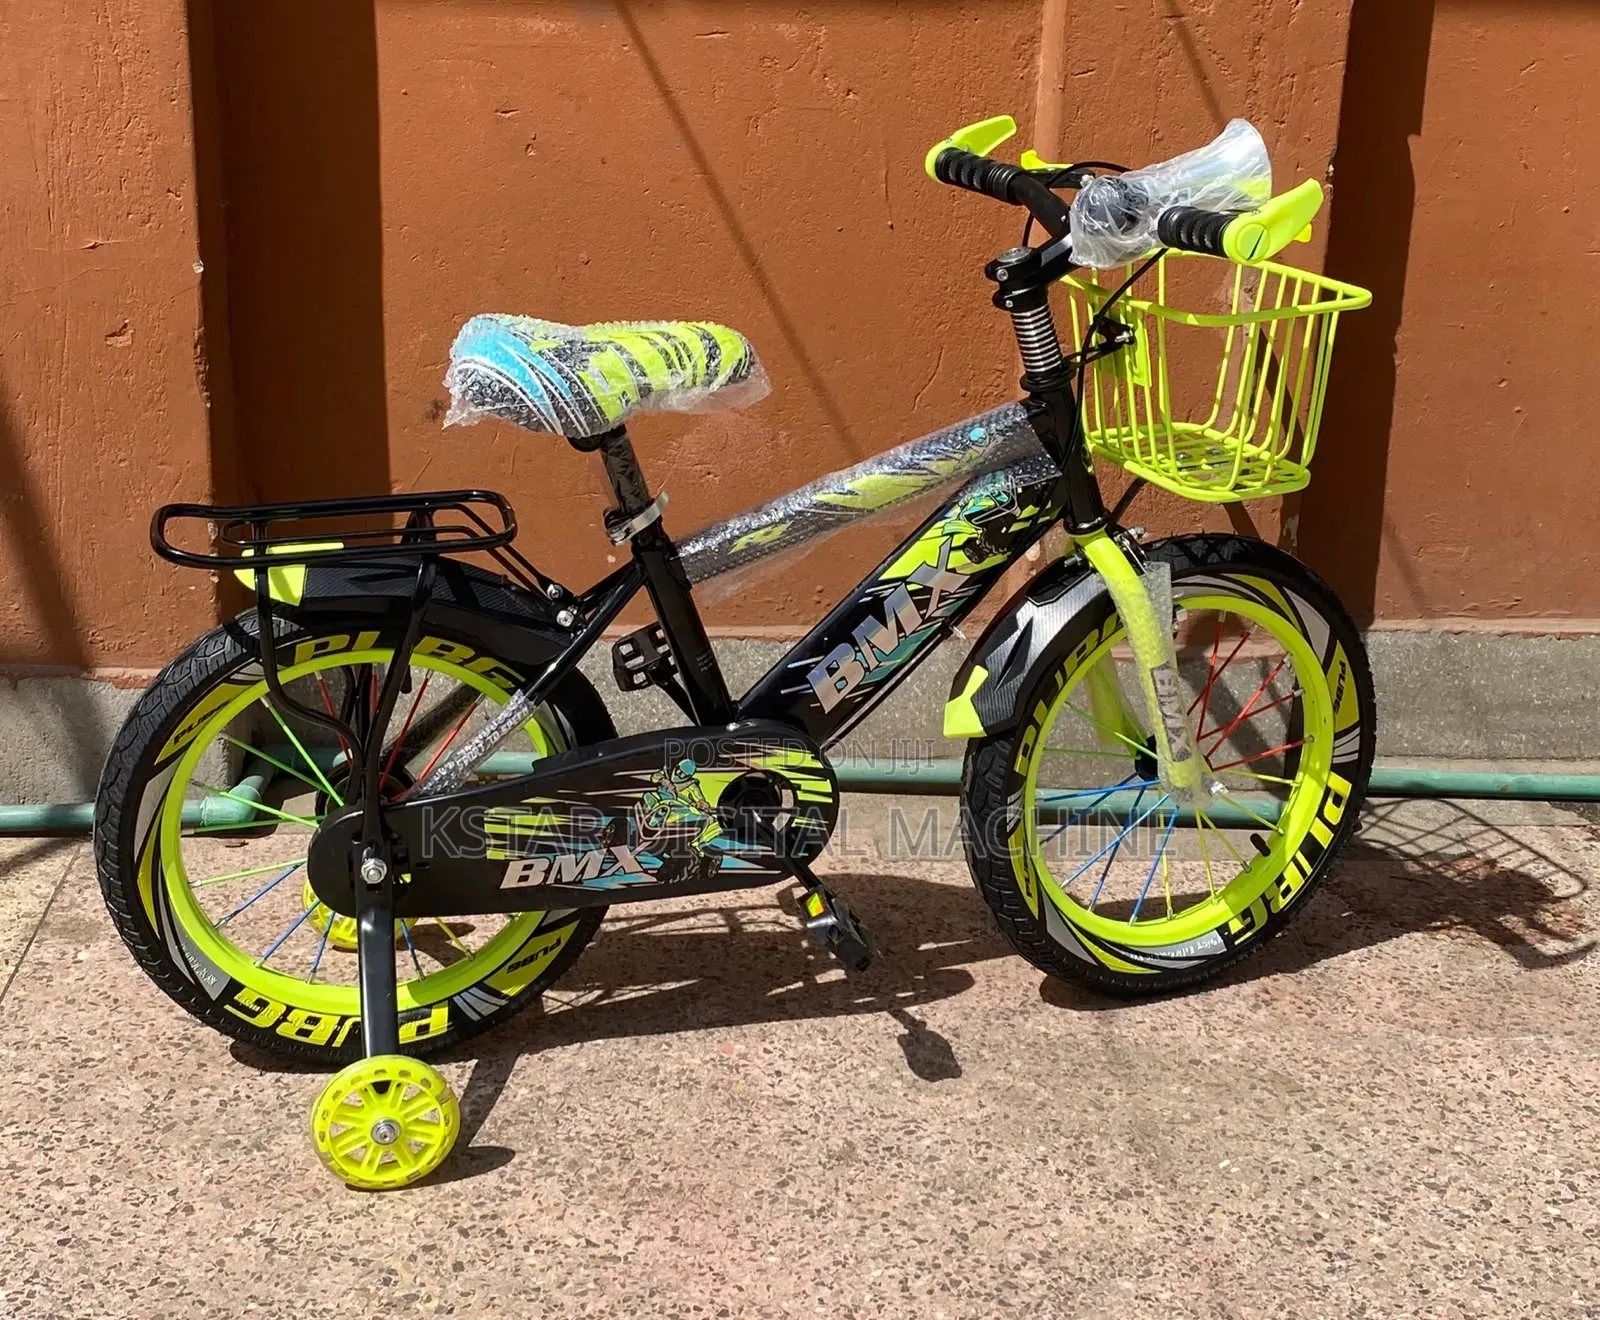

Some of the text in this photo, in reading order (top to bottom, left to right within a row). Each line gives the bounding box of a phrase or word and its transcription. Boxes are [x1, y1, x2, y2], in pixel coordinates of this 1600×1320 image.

[806, 536, 969, 714] BMX
[173, 698, 232, 746] PU
[500, 840, 656, 889] BMX
[506, 935, 562, 974] PUBG
